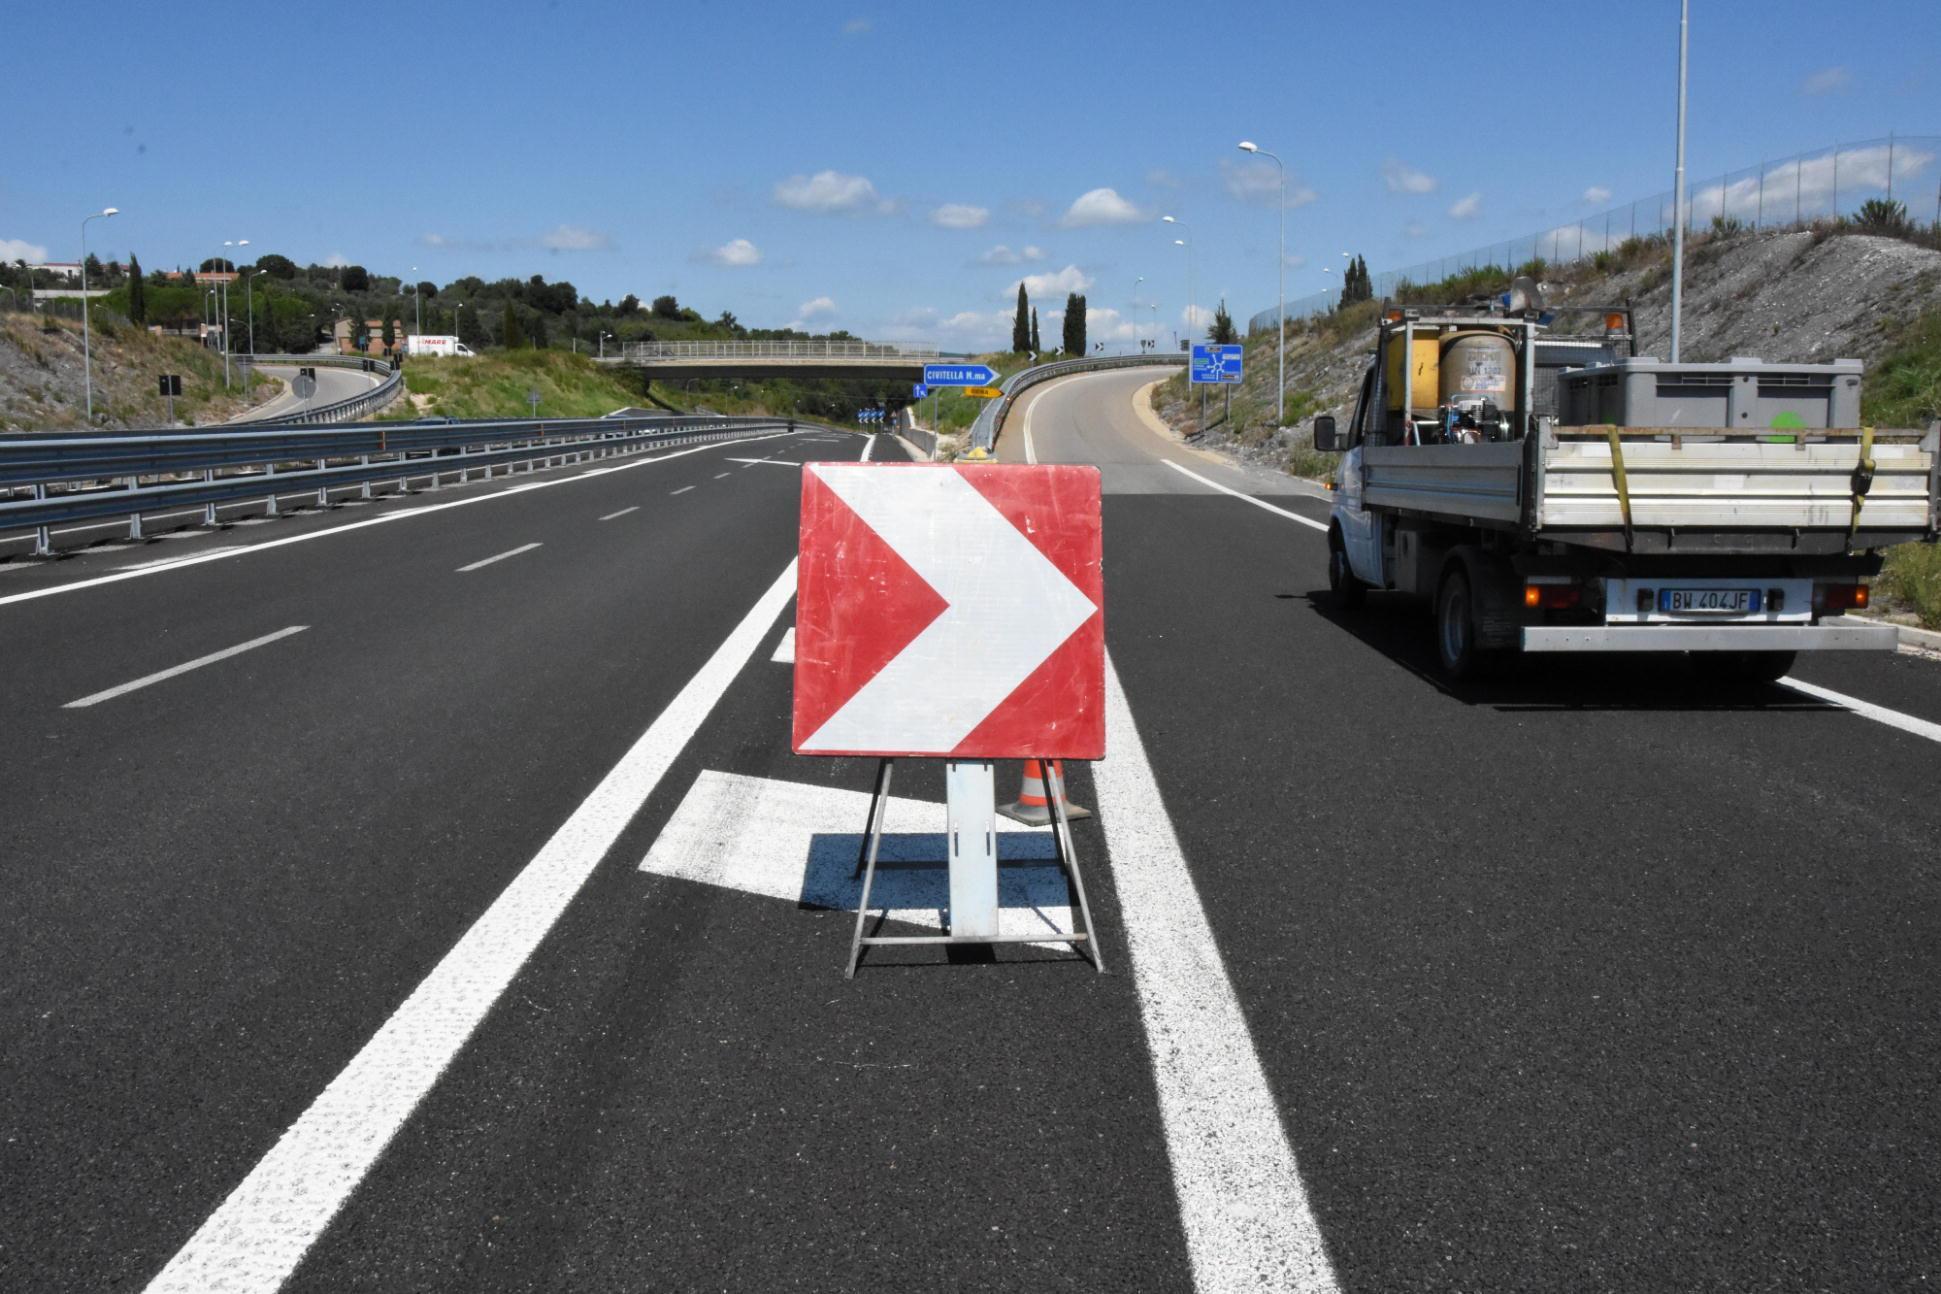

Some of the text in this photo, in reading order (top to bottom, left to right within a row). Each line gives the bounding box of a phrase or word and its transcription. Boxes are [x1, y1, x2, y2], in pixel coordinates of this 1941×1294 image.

[927, 370, 963, 380] CIVITELLA
[1672, 591, 1693, 609] BW
[1699, 591, 1748, 609] 404JF
